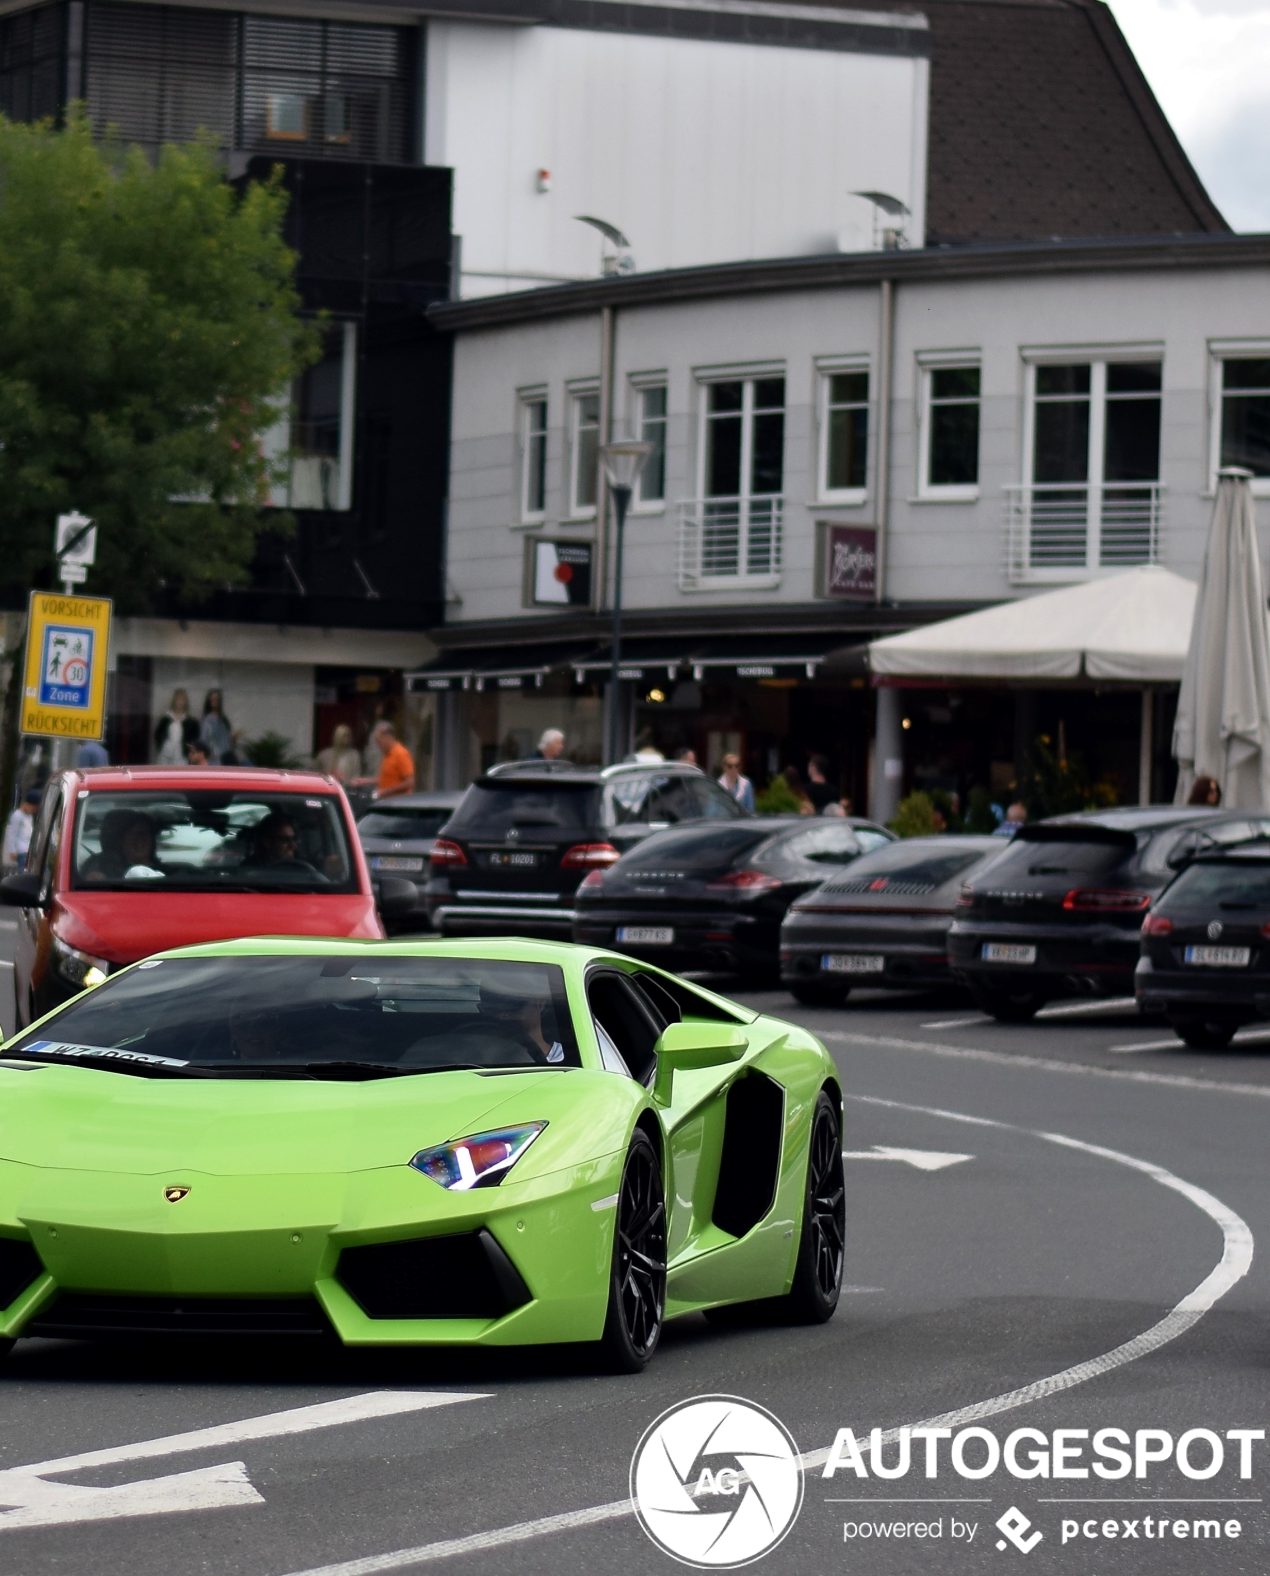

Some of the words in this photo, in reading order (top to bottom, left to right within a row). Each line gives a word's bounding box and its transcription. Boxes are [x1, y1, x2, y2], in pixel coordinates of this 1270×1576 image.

[41, 599, 102, 619] VORSICHT
[70, 666, 84, 681] 30
[49, 687, 80, 702] Zone
[27, 710, 97, 735] RÜCKSICHT
[511, 854, 534, 864] 10201
